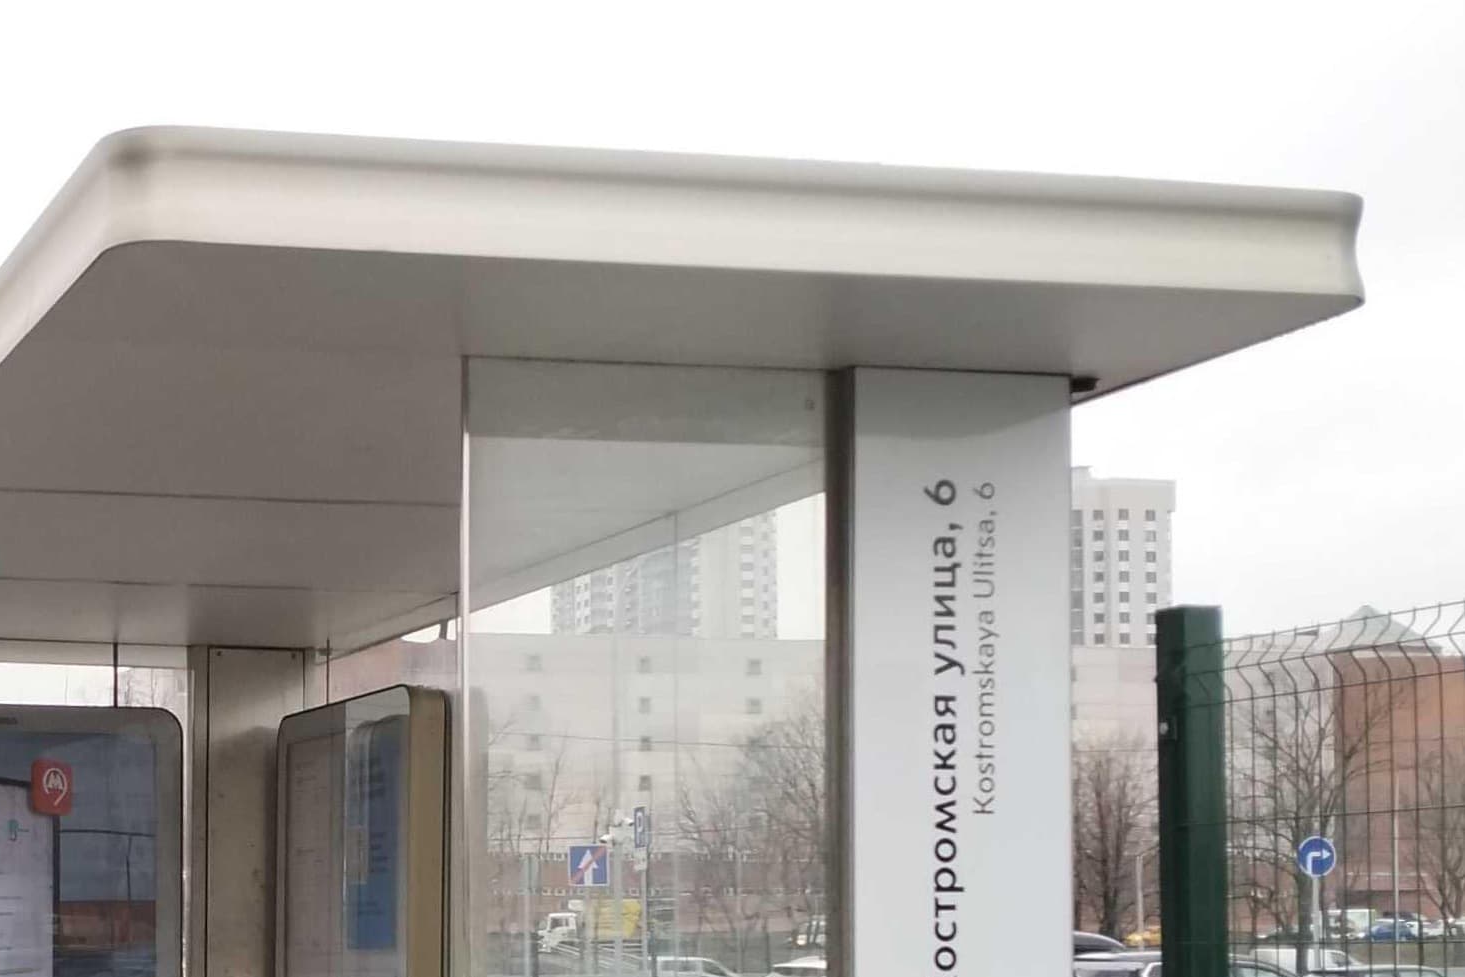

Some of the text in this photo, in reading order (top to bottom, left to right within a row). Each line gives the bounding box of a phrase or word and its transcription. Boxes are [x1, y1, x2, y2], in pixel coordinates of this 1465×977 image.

[923, 479, 958, 506] 6
[933, 522, 965, 676] улица,
[972, 482, 1000, 815] Kostromskaya Ulitsa, 6
